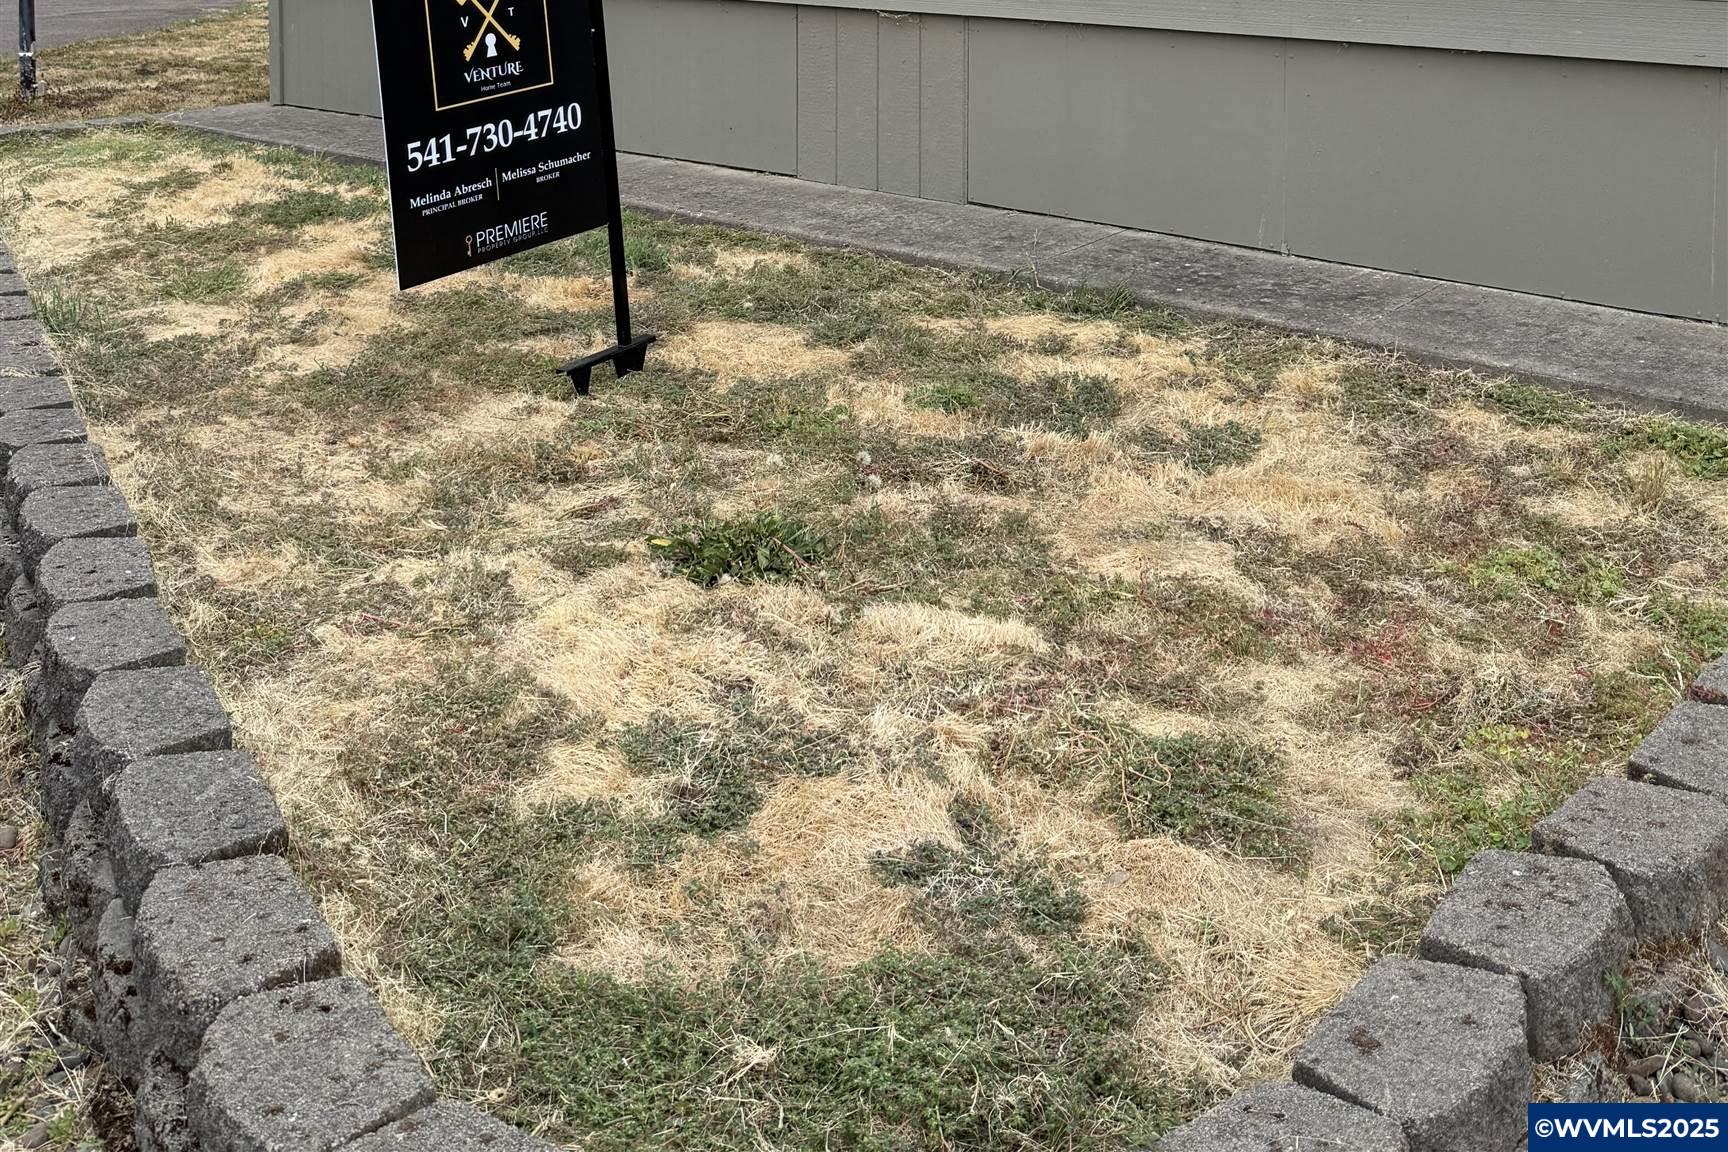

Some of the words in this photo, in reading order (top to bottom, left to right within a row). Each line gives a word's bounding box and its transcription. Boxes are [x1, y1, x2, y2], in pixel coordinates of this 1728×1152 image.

[460, 15, 469, 28] V
[507, 6, 515, 17] T
[464, 61, 524, 83] VENTURE
[407, 102, 582, 173] 541-730-4740
[501, 167, 537, 183] Melissa
[538, 152, 592, 173] Schumacher
[535, 171, 561, 183] BROKER
[409, 189, 452, 209] Melinda
[454, 177, 493, 197] Abresch
[421, 201, 457, 217] PRINCIPAL
[457, 193, 484, 207] BROKER
[476, 211, 549, 248] PREMIERE
